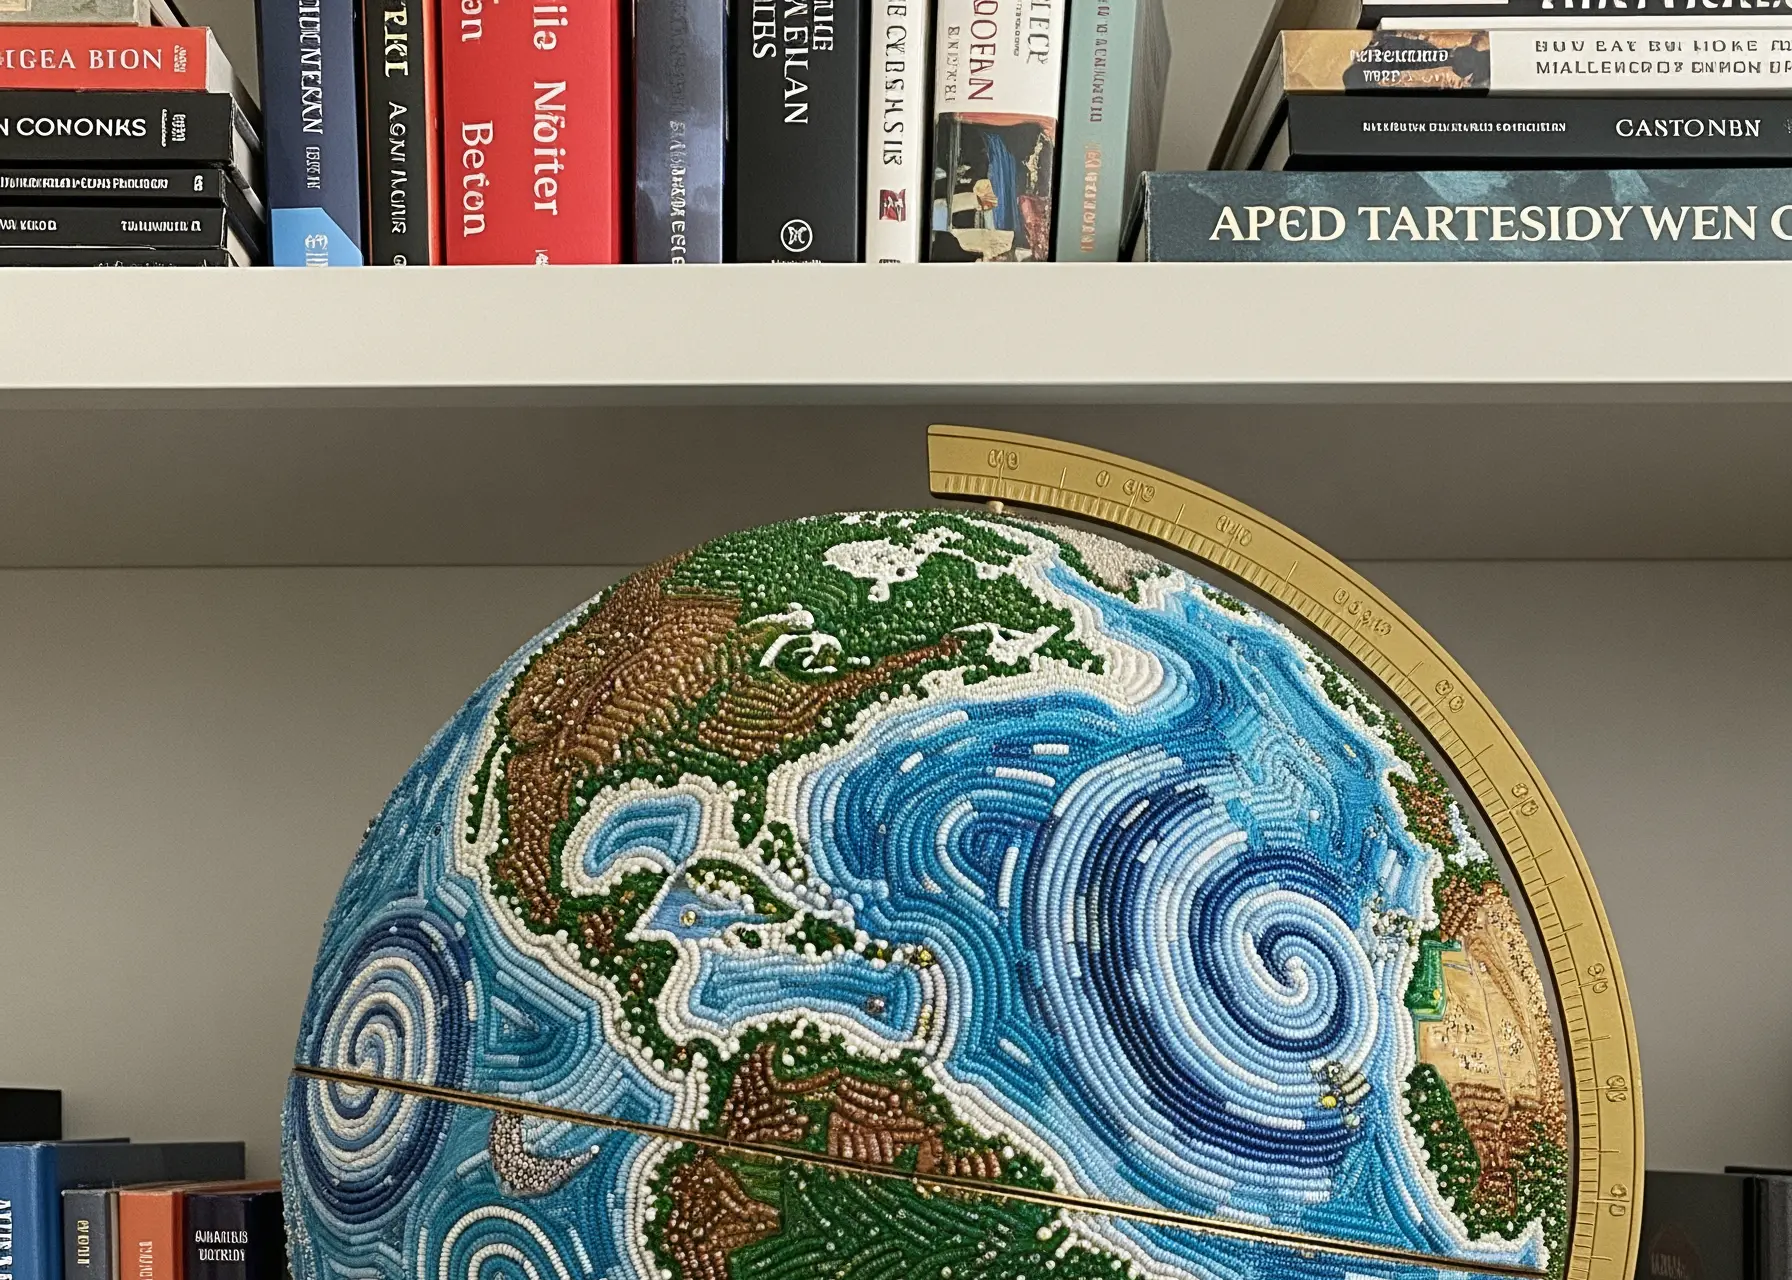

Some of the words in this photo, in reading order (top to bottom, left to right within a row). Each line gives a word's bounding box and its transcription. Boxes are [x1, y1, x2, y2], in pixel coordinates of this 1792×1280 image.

[0, 49, 76, 69] IGEA
[89, 49, 162, 69] BION
[1639, 205, 1758, 242] WEN
